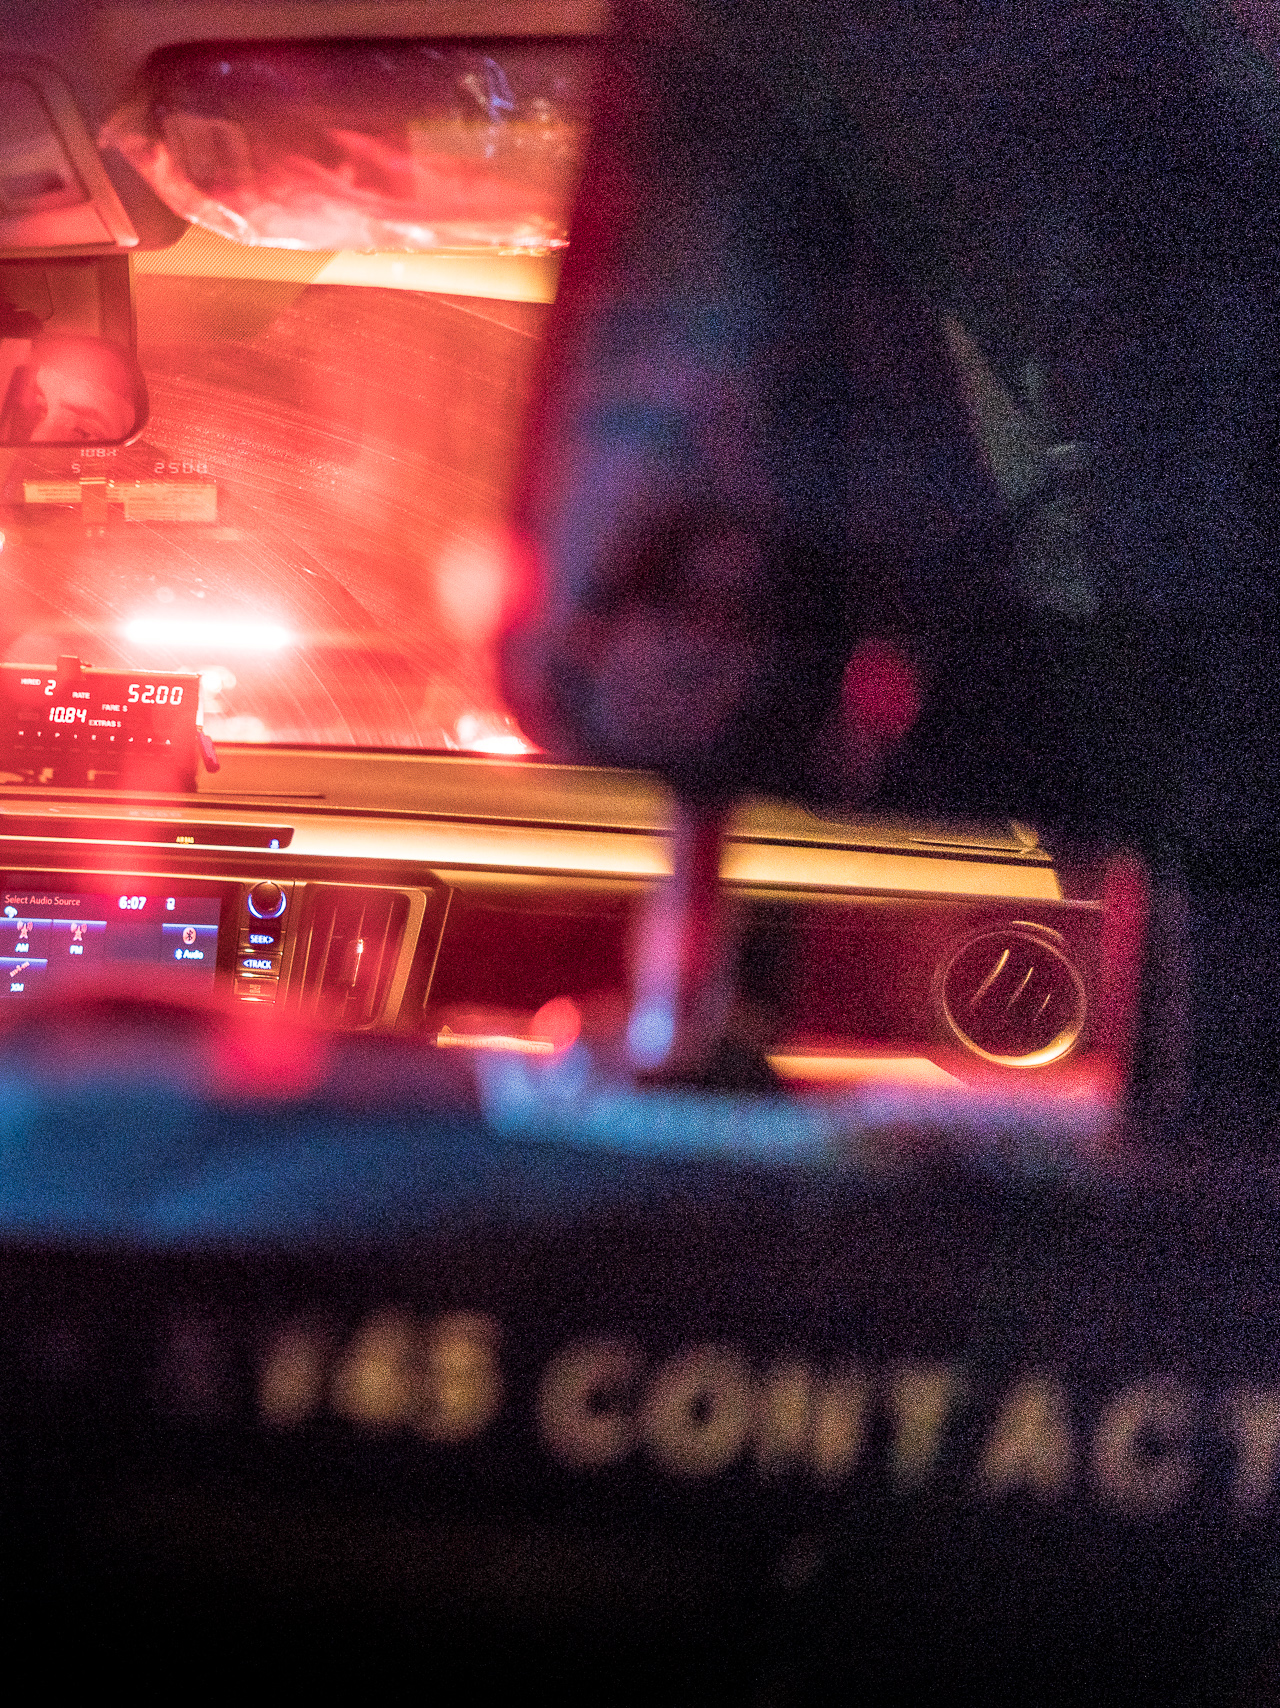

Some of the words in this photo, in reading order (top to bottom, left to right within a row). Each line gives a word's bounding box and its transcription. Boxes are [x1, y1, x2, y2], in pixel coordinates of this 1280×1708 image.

[44, 679, 57, 696] 2
[127, 683, 184, 705] 52.00
[102, 703, 120, 711] FARE
[4, 894, 28, 904] Select
[29, 895, 52, 905] Audio
[53, 896, 81, 906] Source
[119, 896, 147, 910] 6:07
[15, 943, 29, 953] AM
[69, 945, 83, 955] FM
